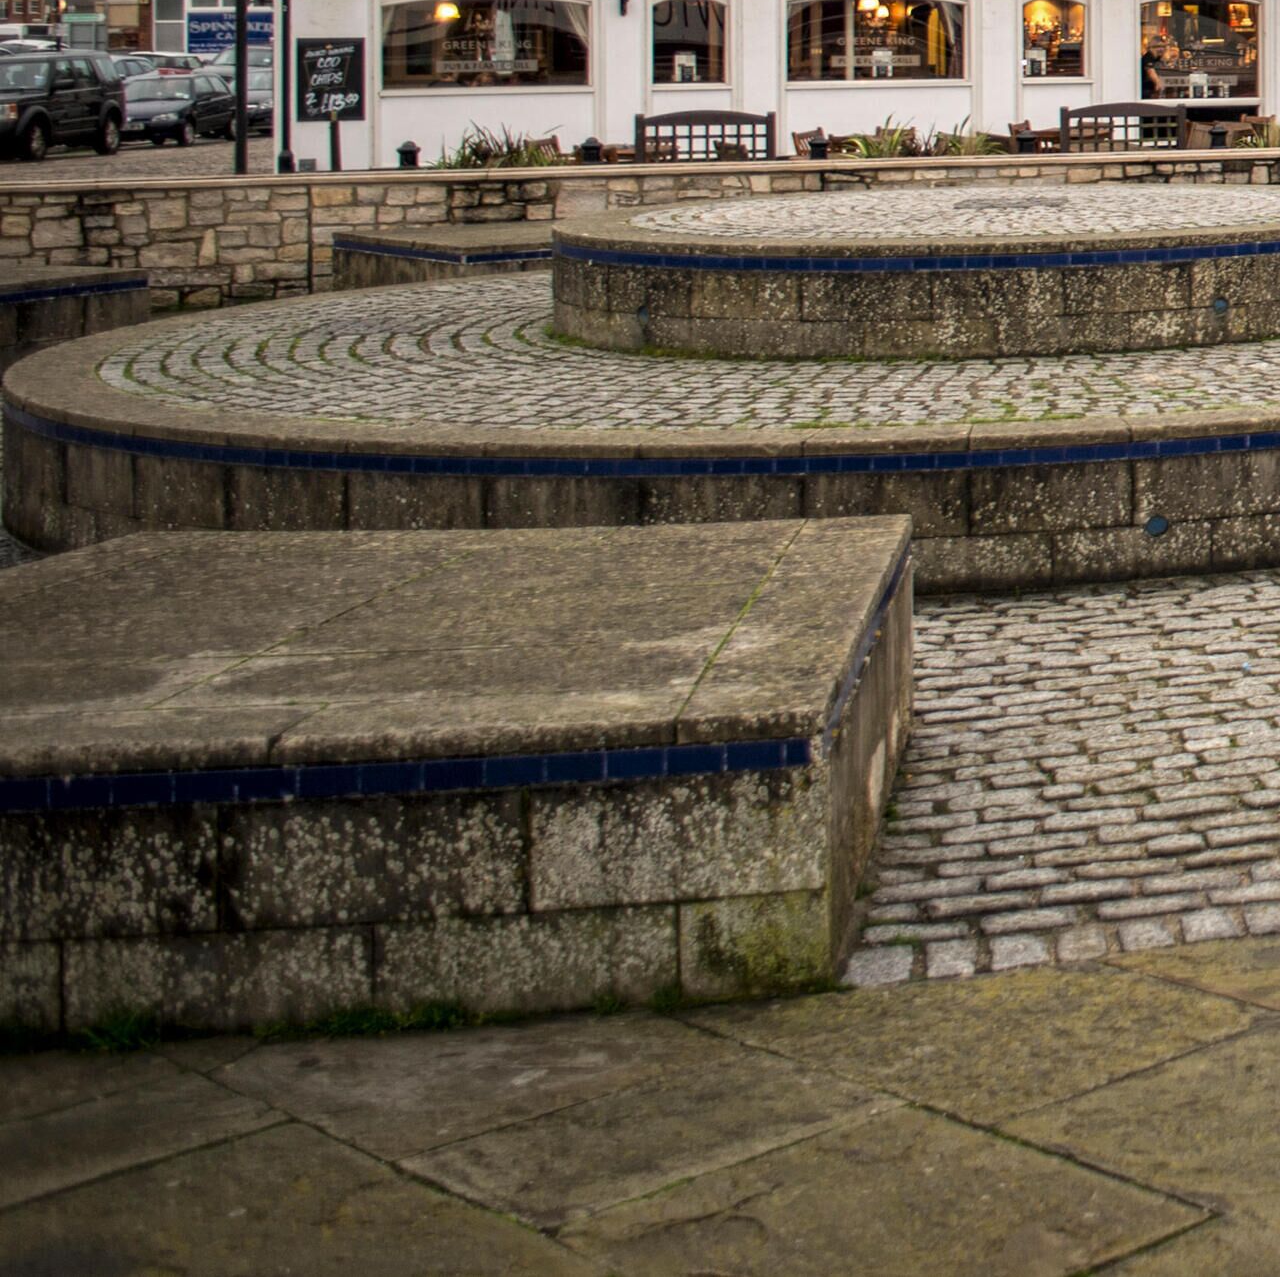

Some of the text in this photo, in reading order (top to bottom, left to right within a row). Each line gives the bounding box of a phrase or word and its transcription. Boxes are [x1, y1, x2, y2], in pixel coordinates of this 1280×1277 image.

[189, 20, 273, 34] SPINNKER
[1206, 58, 1234, 67] KING
[311, 72, 344, 87] CHIPS
